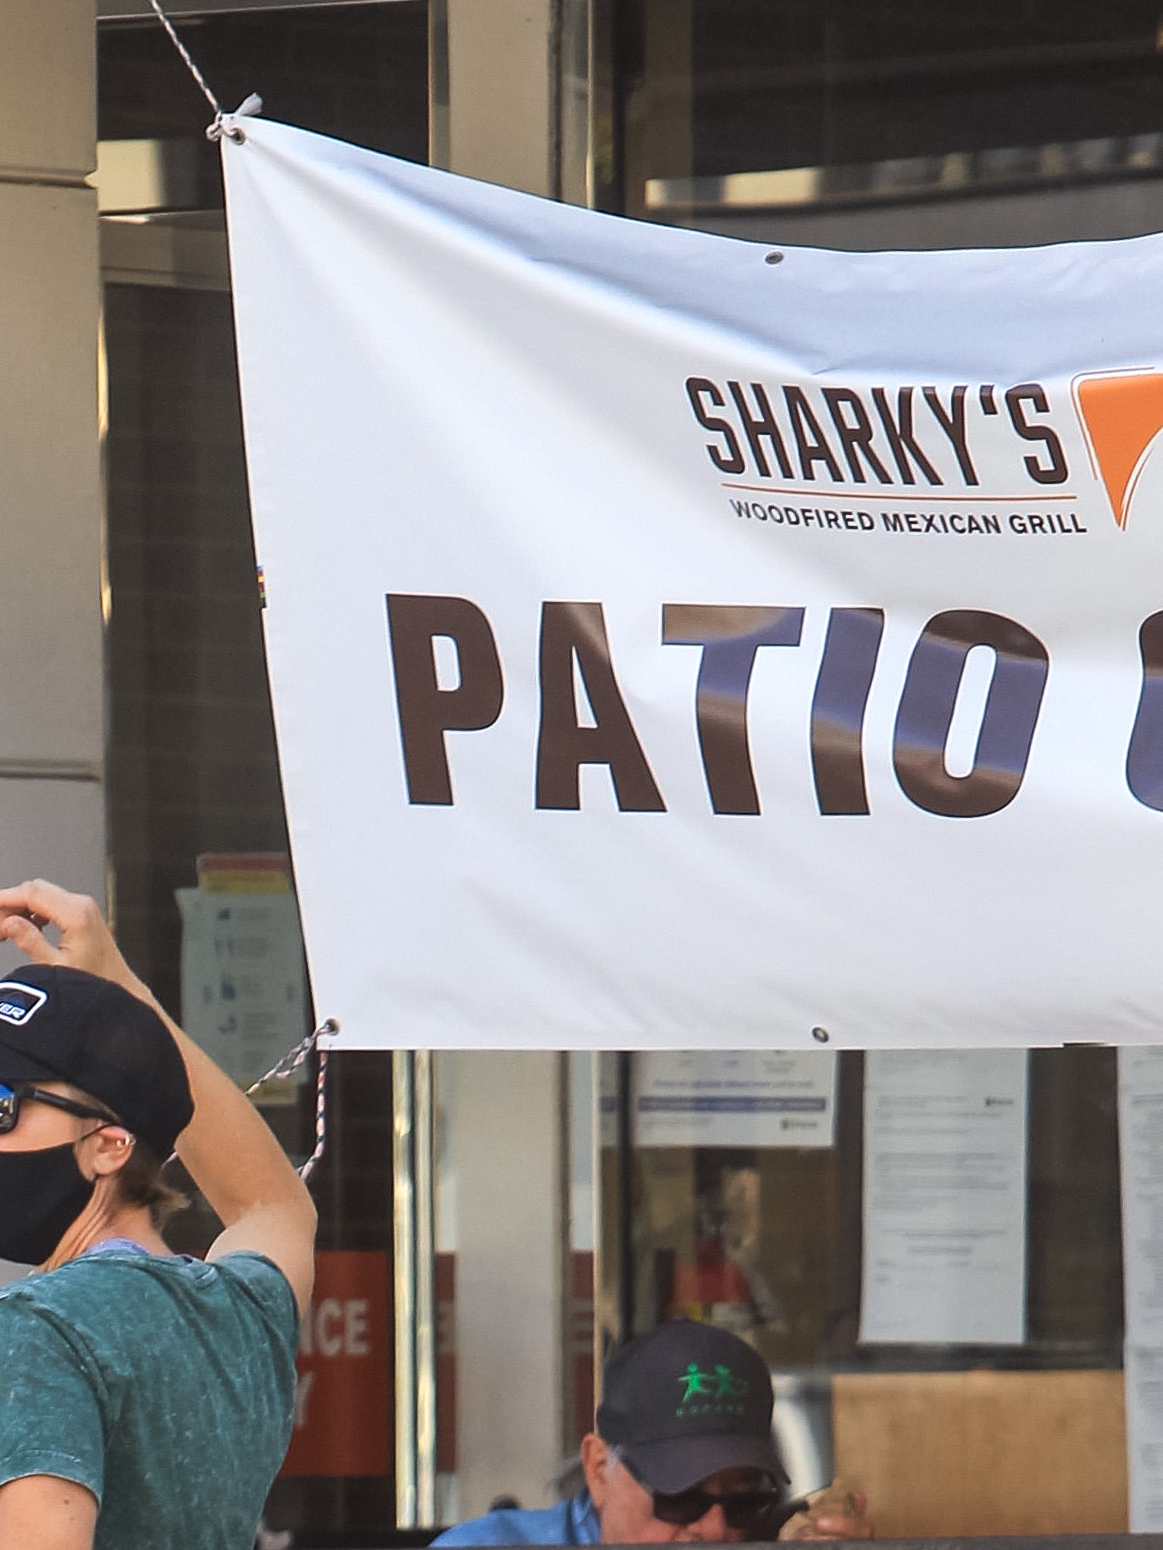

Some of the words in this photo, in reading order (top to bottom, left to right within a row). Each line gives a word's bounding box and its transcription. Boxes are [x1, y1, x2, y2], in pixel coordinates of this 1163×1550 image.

[685, 376, 1069, 486] SHARKY'S
[730, 498, 875, 532] WOODFIRED
[881, 512, 1002, 534] MEXICAN
[1008, 512, 1088, 535] GRILL
[385, 592, 1050, 819] PATIO
